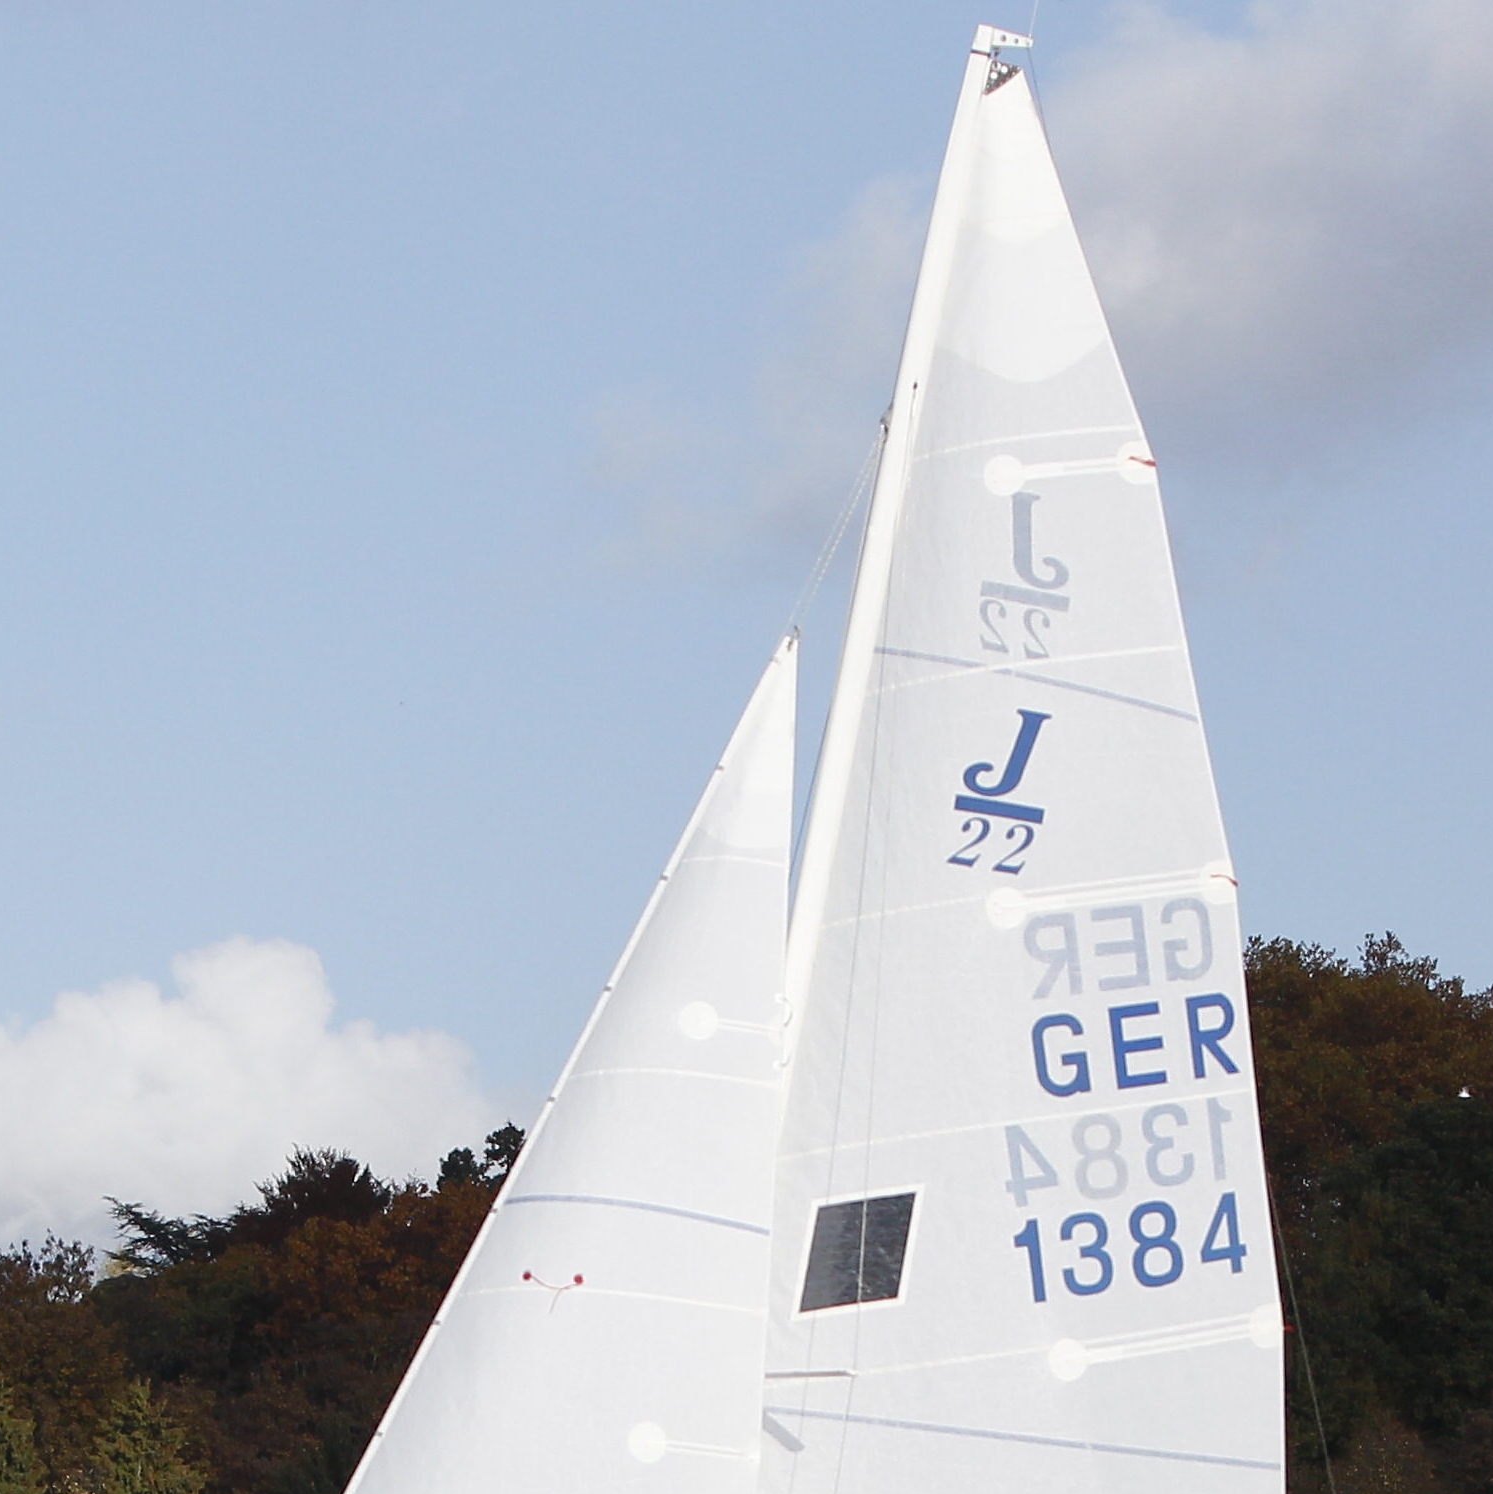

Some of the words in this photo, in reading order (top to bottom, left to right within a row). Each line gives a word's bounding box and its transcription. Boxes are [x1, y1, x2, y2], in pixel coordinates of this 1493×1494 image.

[962, 708, 1053, 797] J
[946, 816, 1036, 875] 22
[1031, 992, 1241, 1098] GER
[1013, 1191, 1248, 1303] 1384
